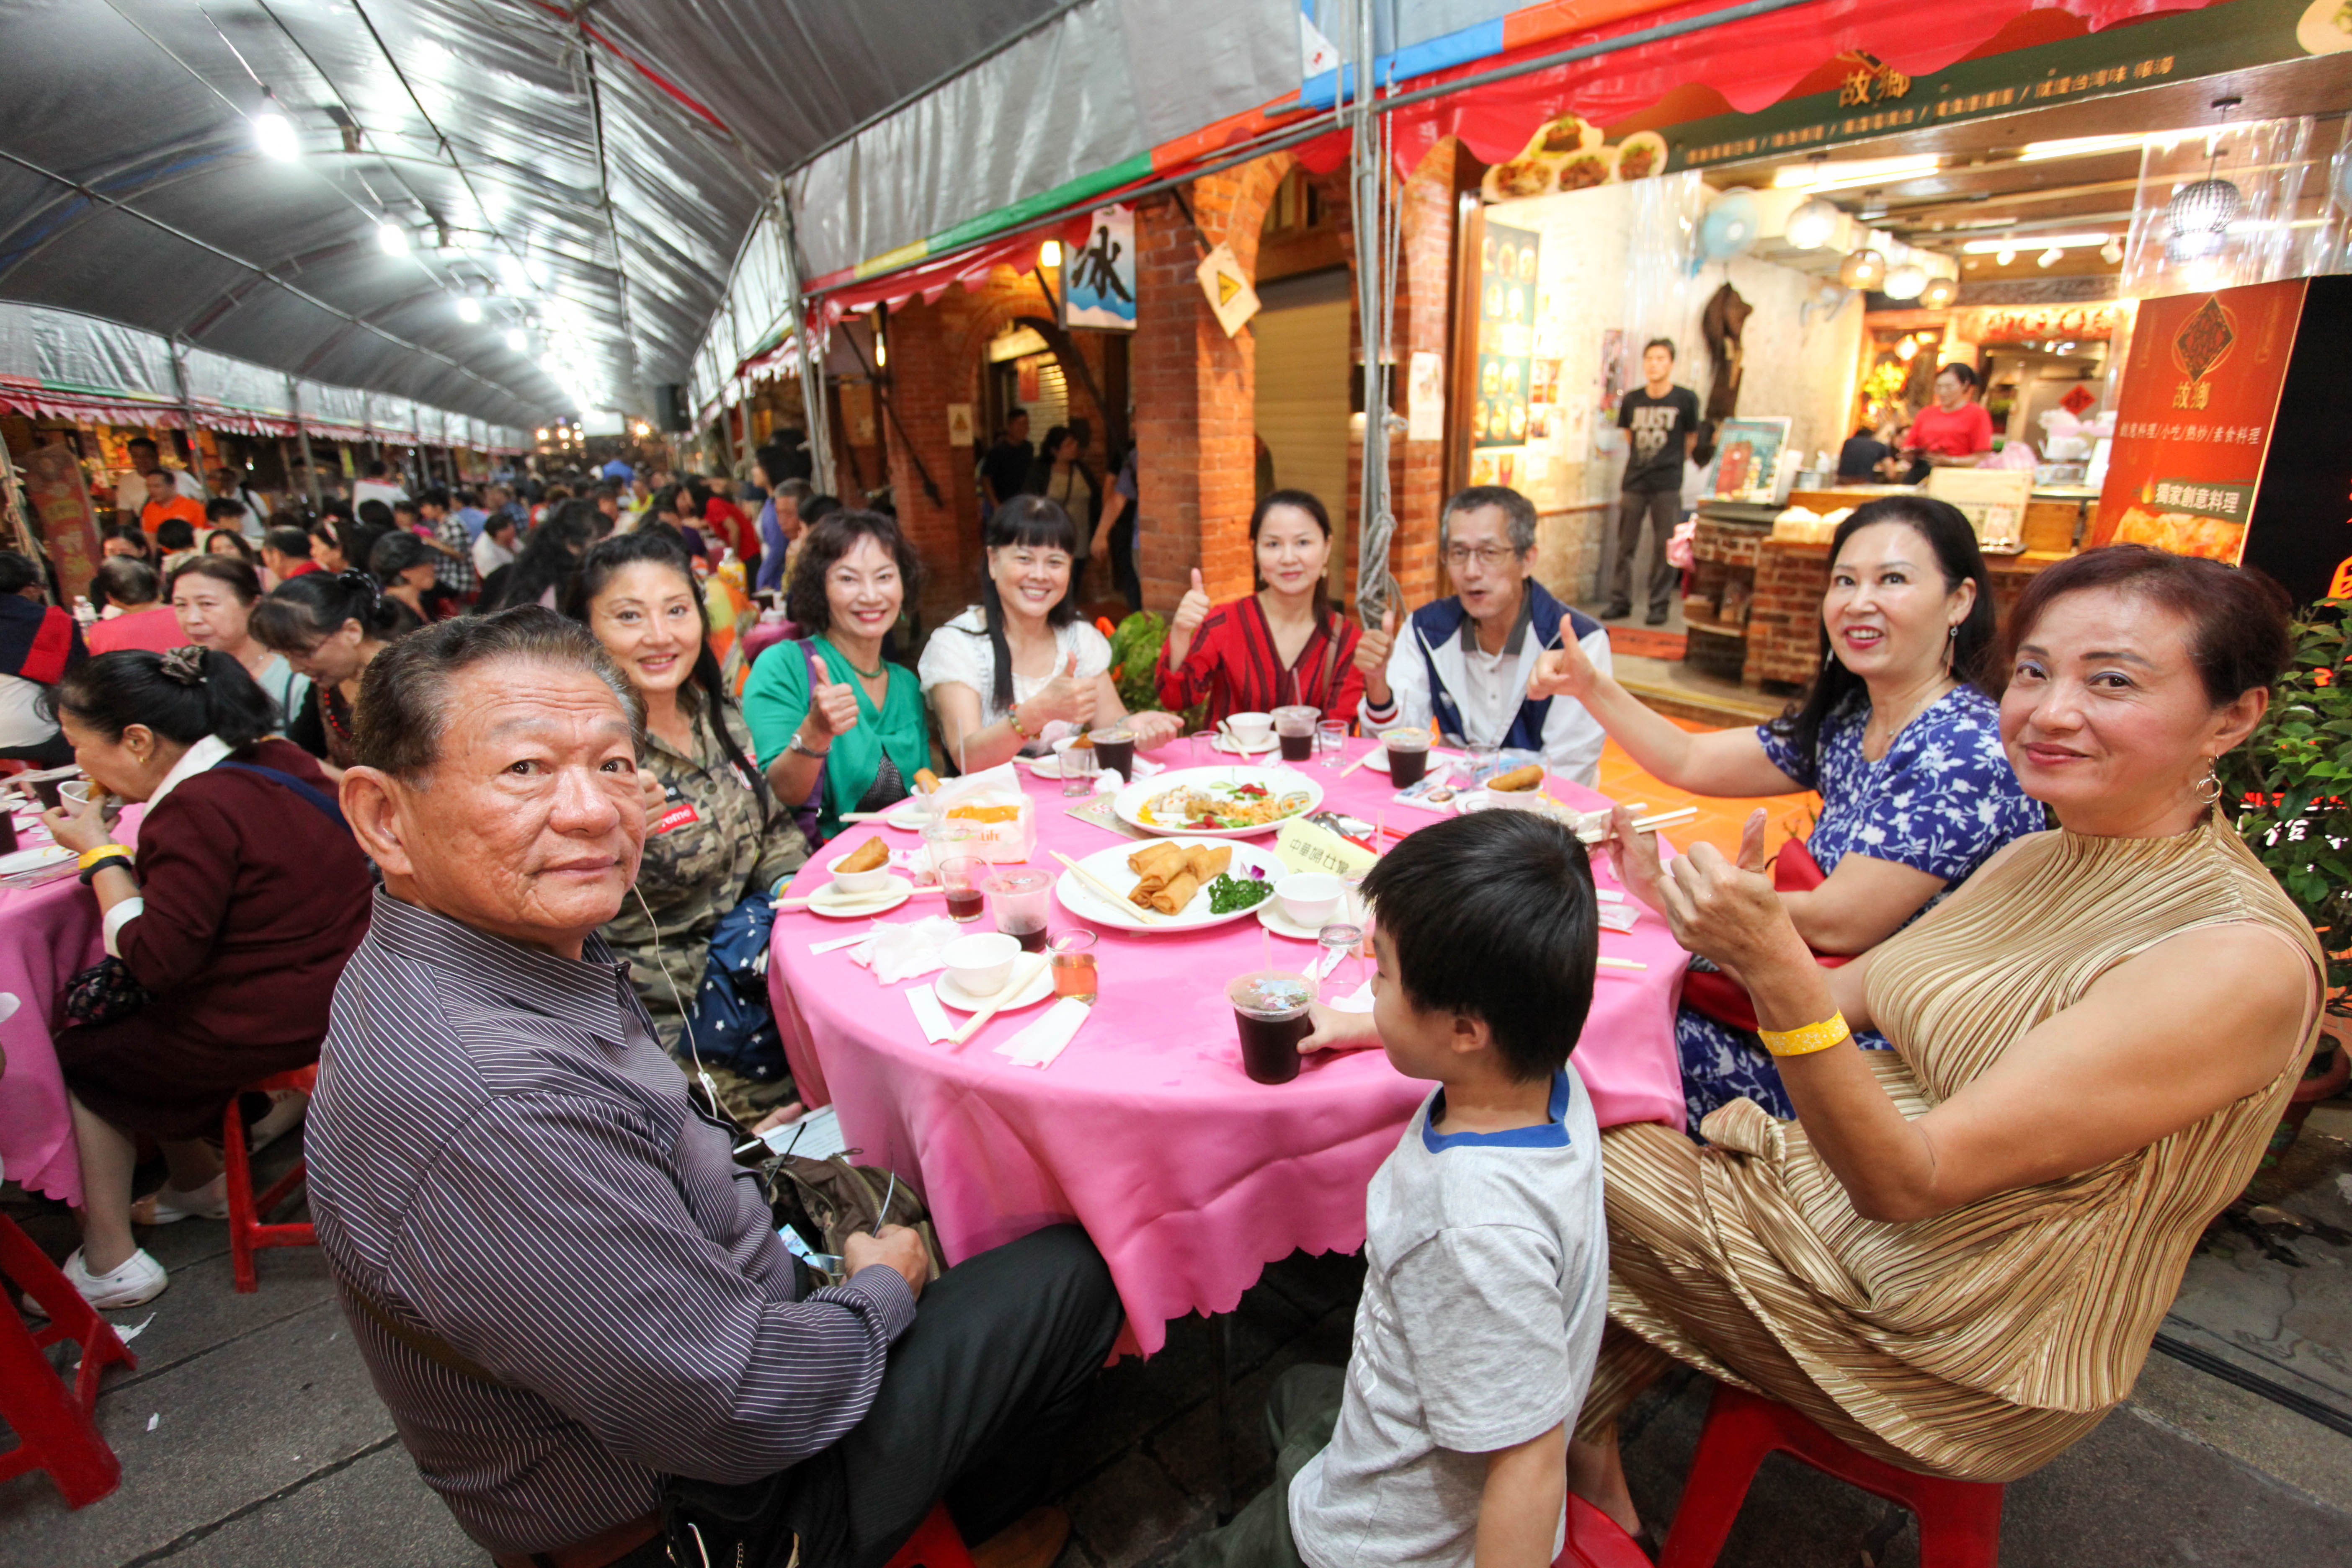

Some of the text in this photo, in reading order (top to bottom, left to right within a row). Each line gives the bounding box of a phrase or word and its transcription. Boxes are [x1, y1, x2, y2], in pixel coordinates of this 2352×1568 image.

[1839, 67, 1911, 108] 故鄉
[2172, 381, 2212, 410] 故鄉
[1630, 406, 1679, 431] JUST
[1635, 430, 1668, 450] DO
[2155, 482, 2241, 514] 獨家創意料理
